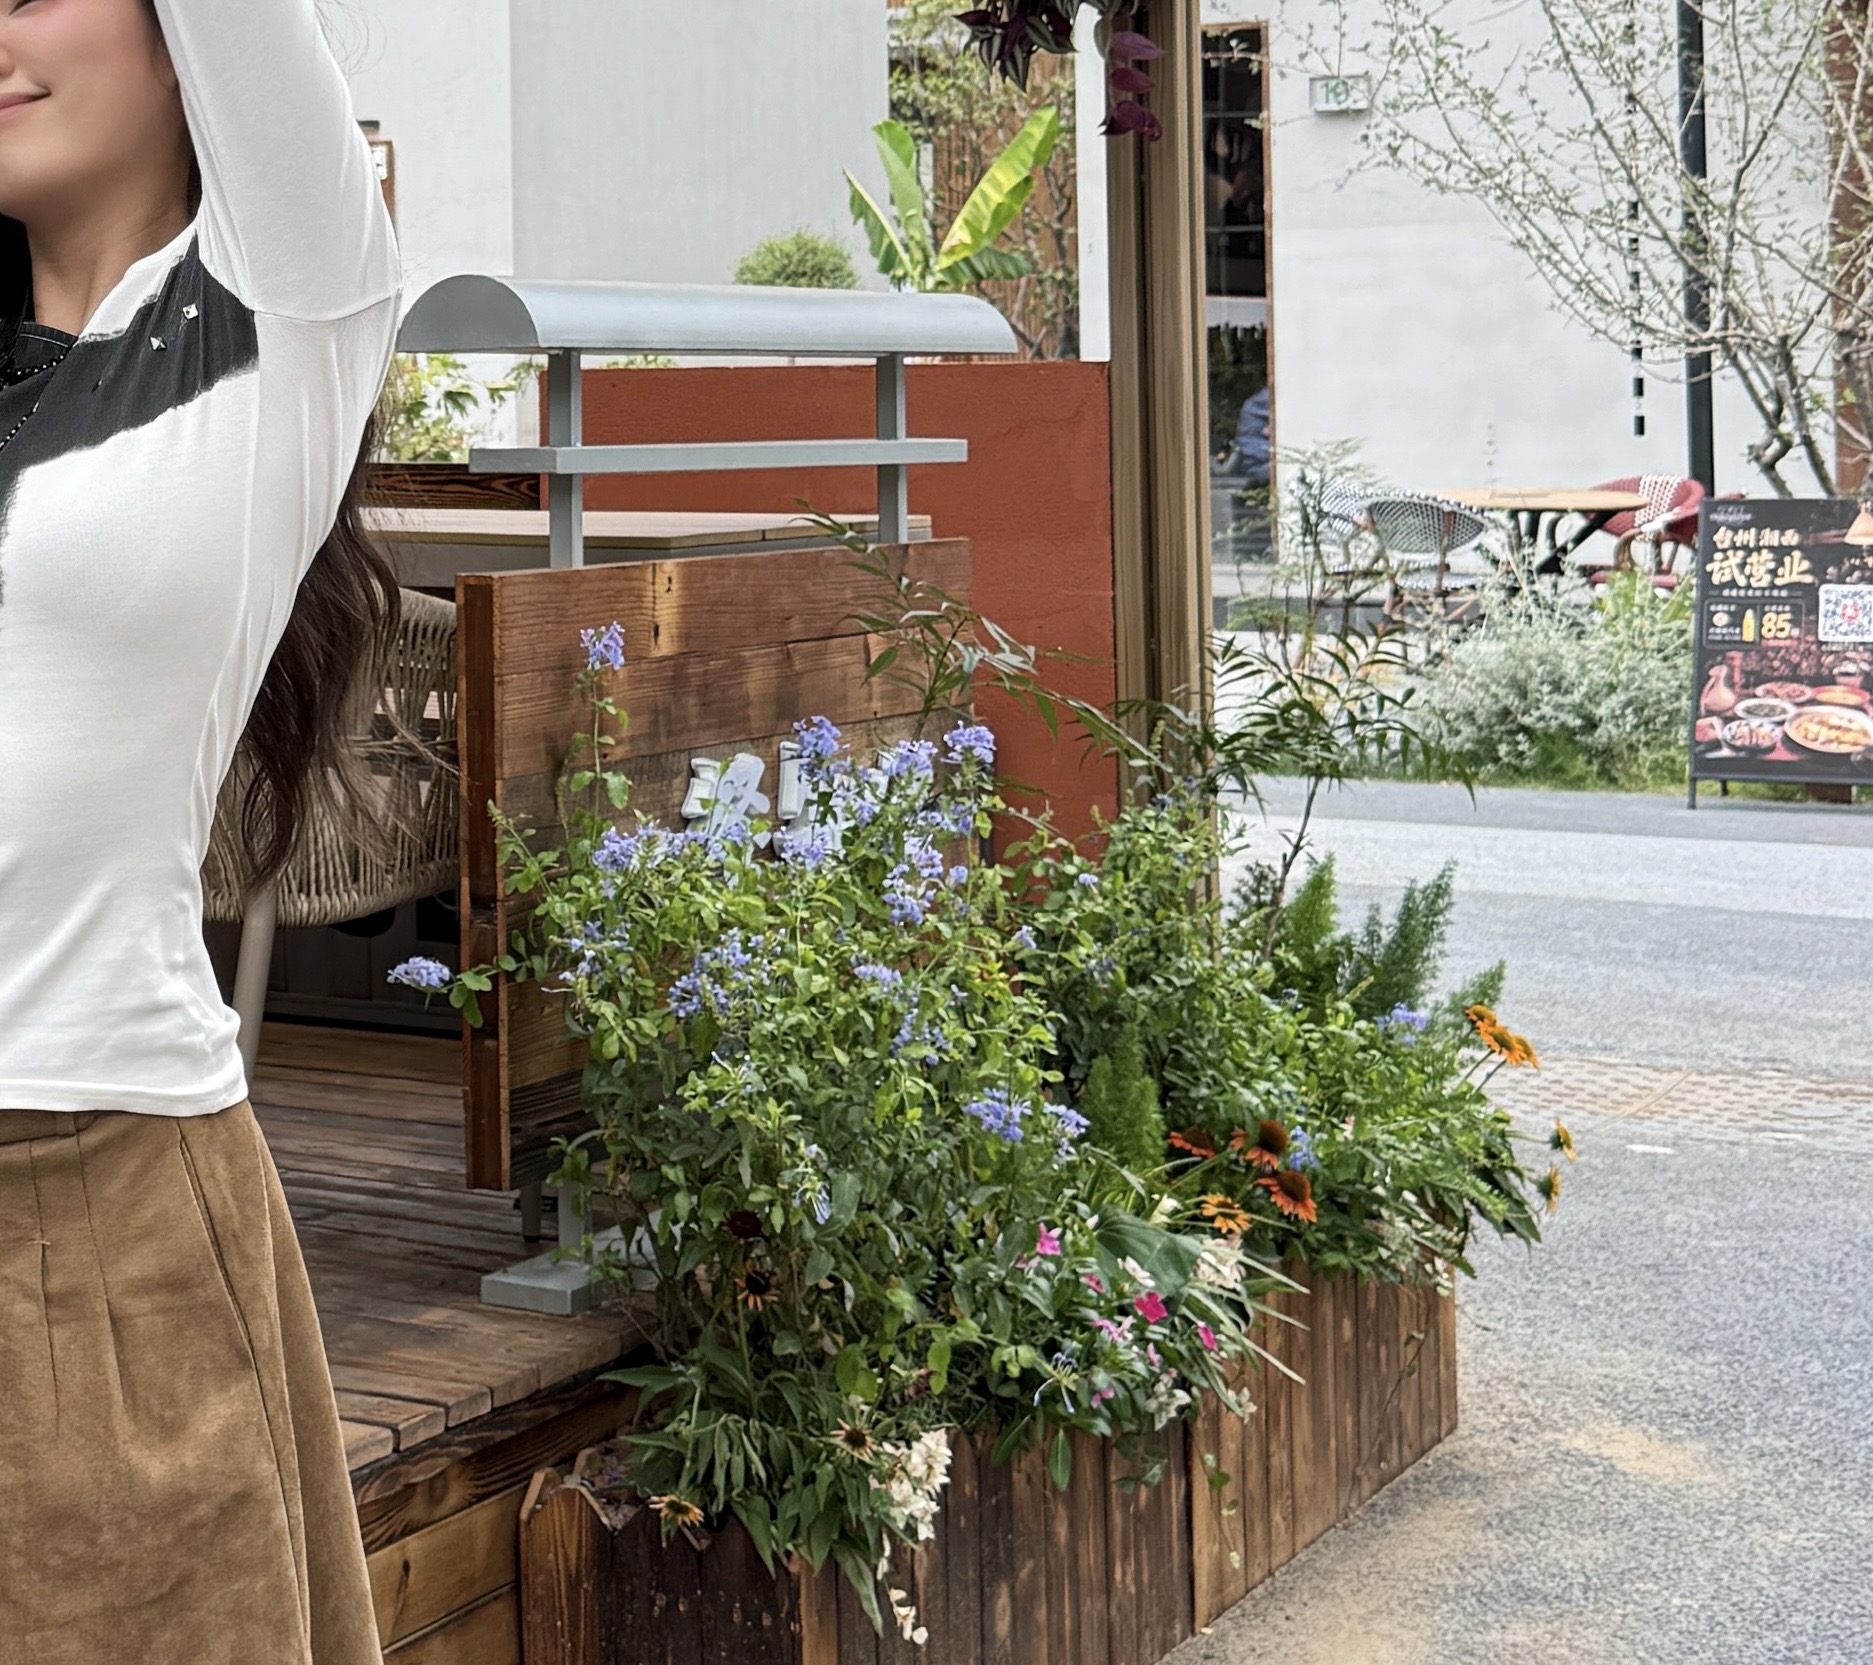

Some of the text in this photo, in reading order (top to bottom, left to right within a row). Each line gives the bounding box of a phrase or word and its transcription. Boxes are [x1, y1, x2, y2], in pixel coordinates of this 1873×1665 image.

[1705, 548, 1817, 588] 试营业
[1761, 611, 1800, 639] 85
